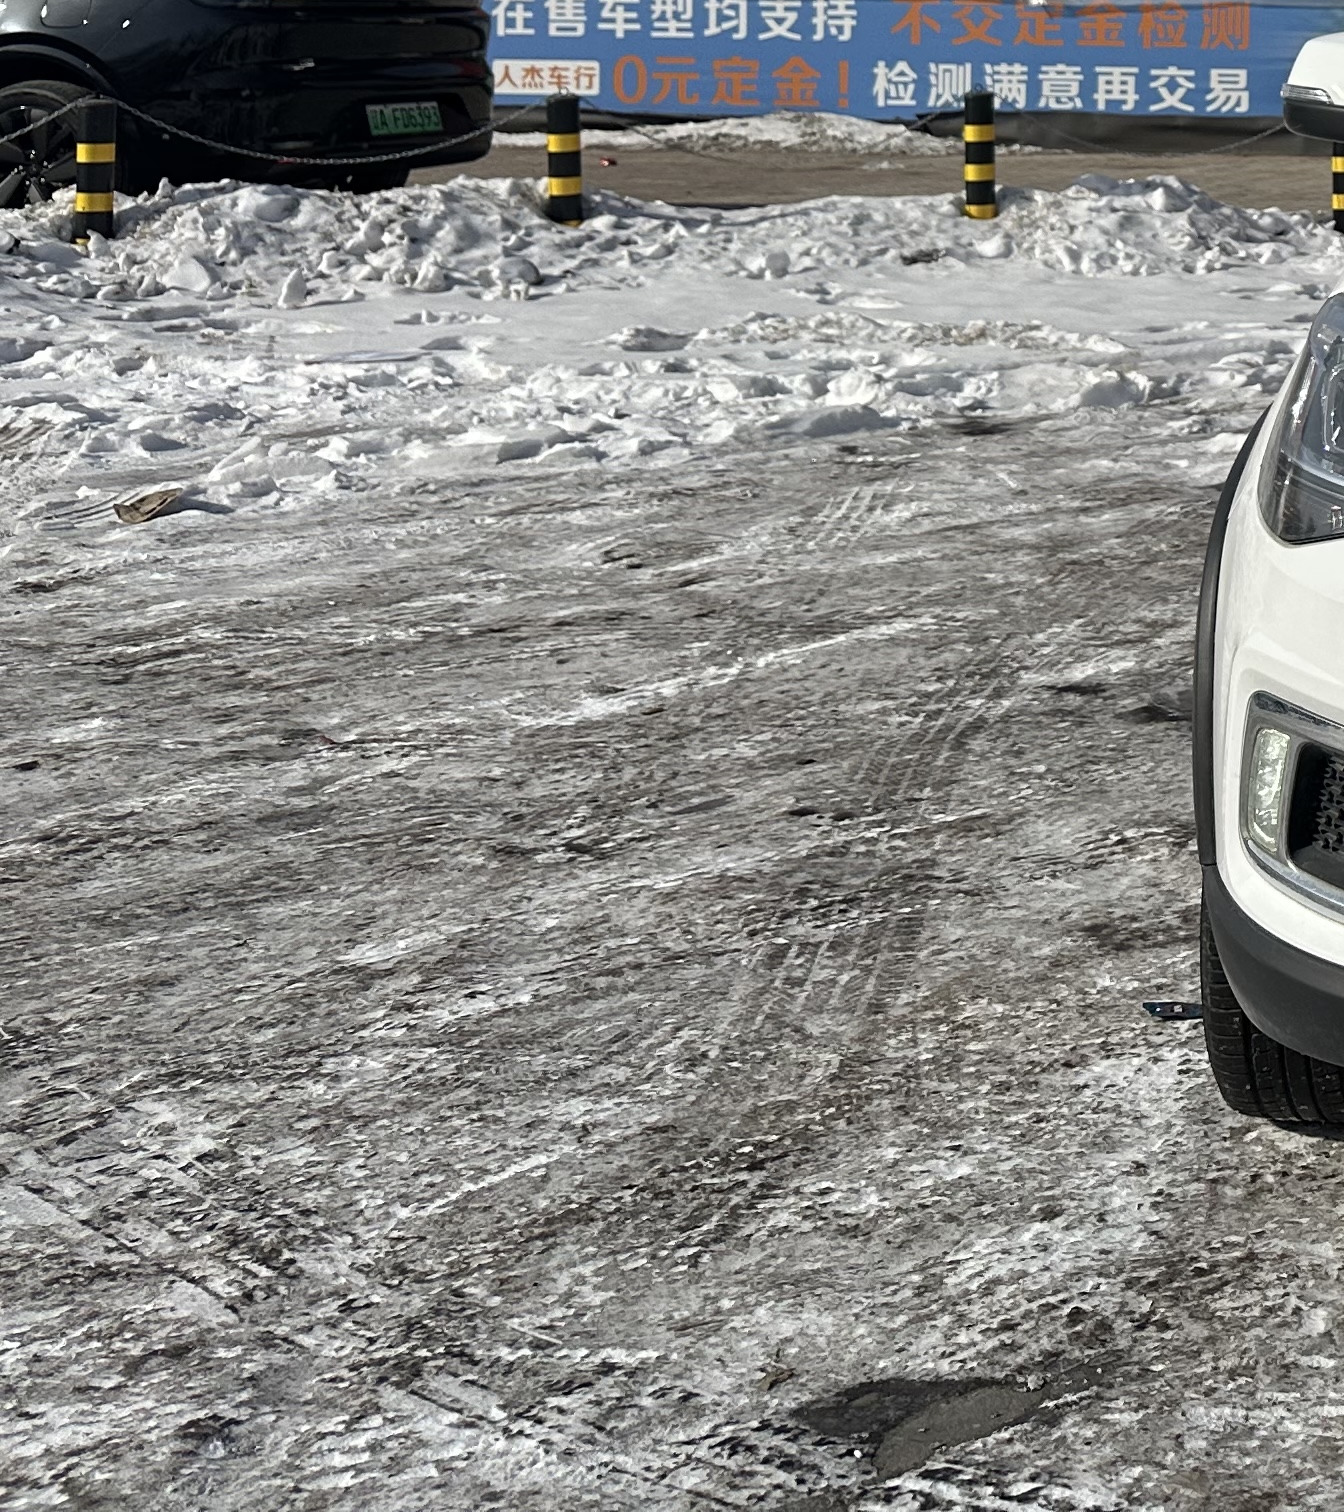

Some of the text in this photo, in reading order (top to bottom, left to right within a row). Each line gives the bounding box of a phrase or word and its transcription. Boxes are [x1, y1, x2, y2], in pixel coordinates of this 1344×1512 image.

[495, 64, 598, 90] 人杰车行
[872, 60, 1250, 114] 检测满意再交易
